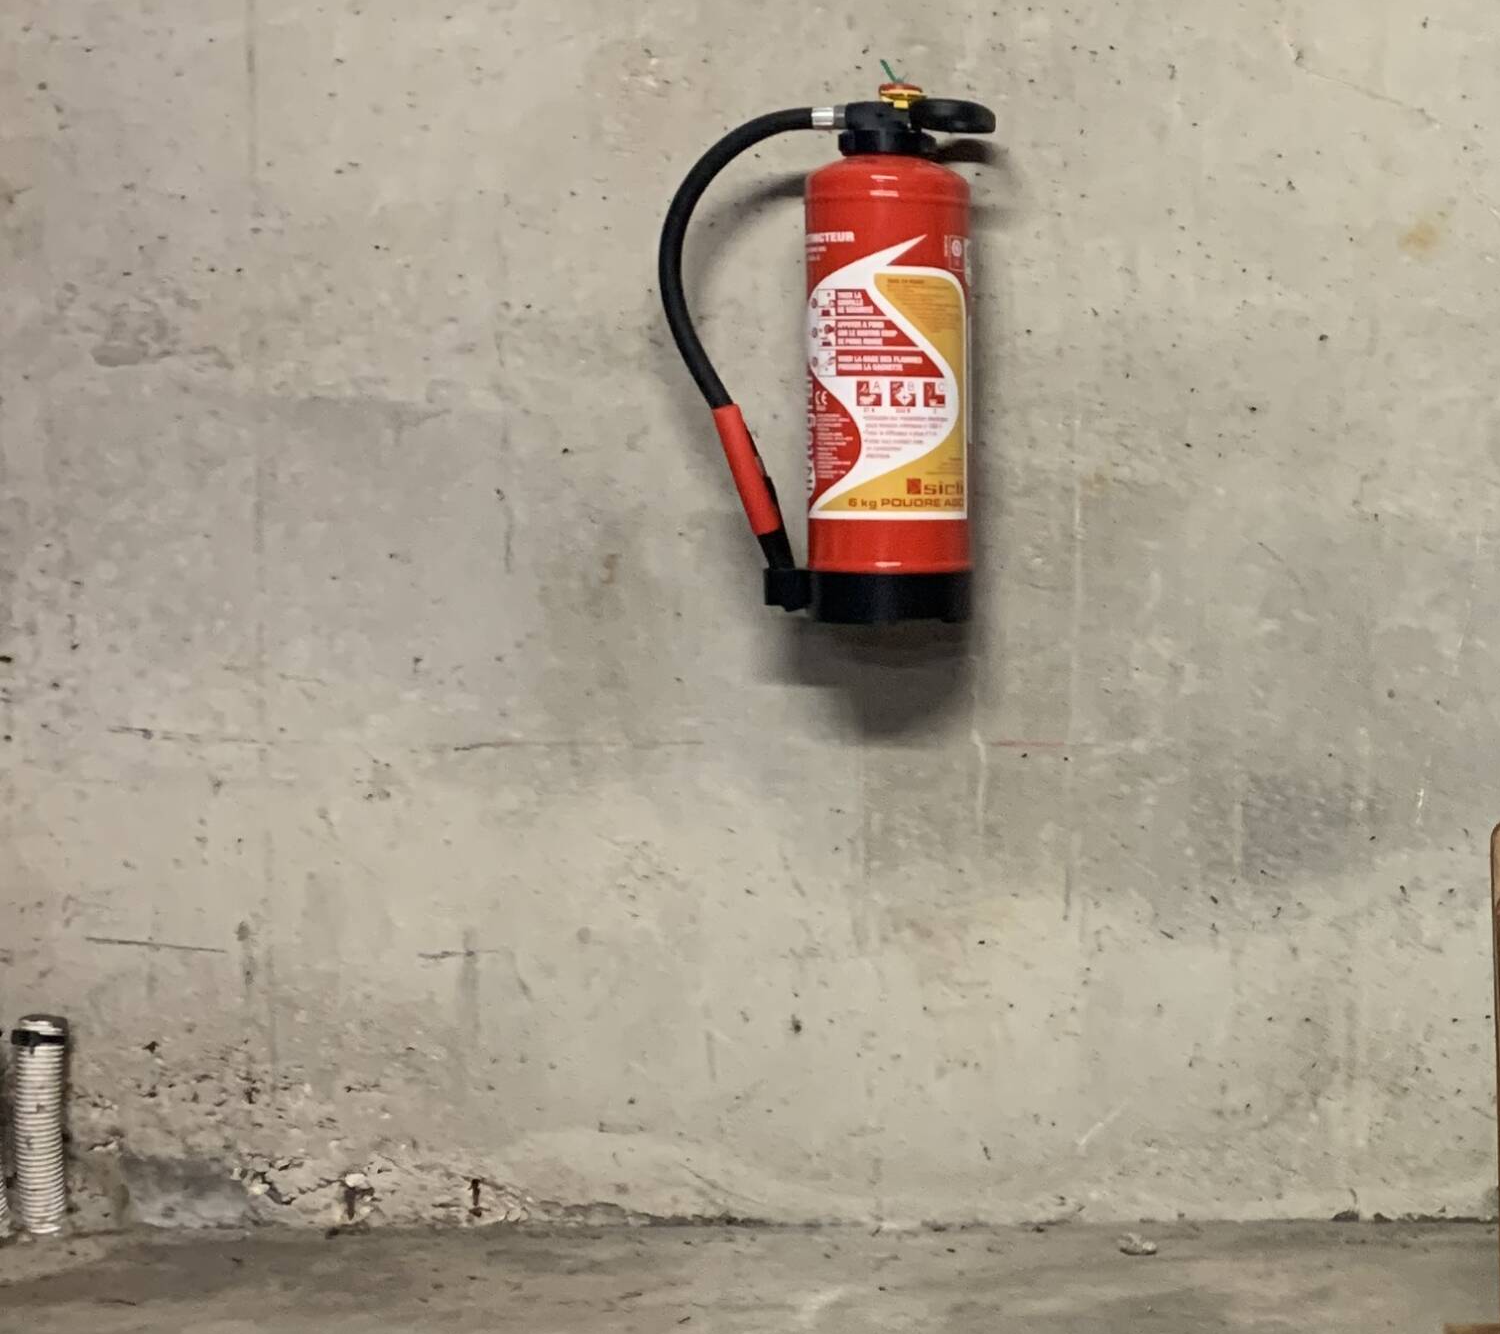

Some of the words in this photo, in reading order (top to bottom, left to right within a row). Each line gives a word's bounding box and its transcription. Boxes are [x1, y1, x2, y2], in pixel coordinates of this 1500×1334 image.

[848, 497, 858, 508] 6
[861, 498, 877, 510] kg
[881, 498, 941, 508] POUDRE
